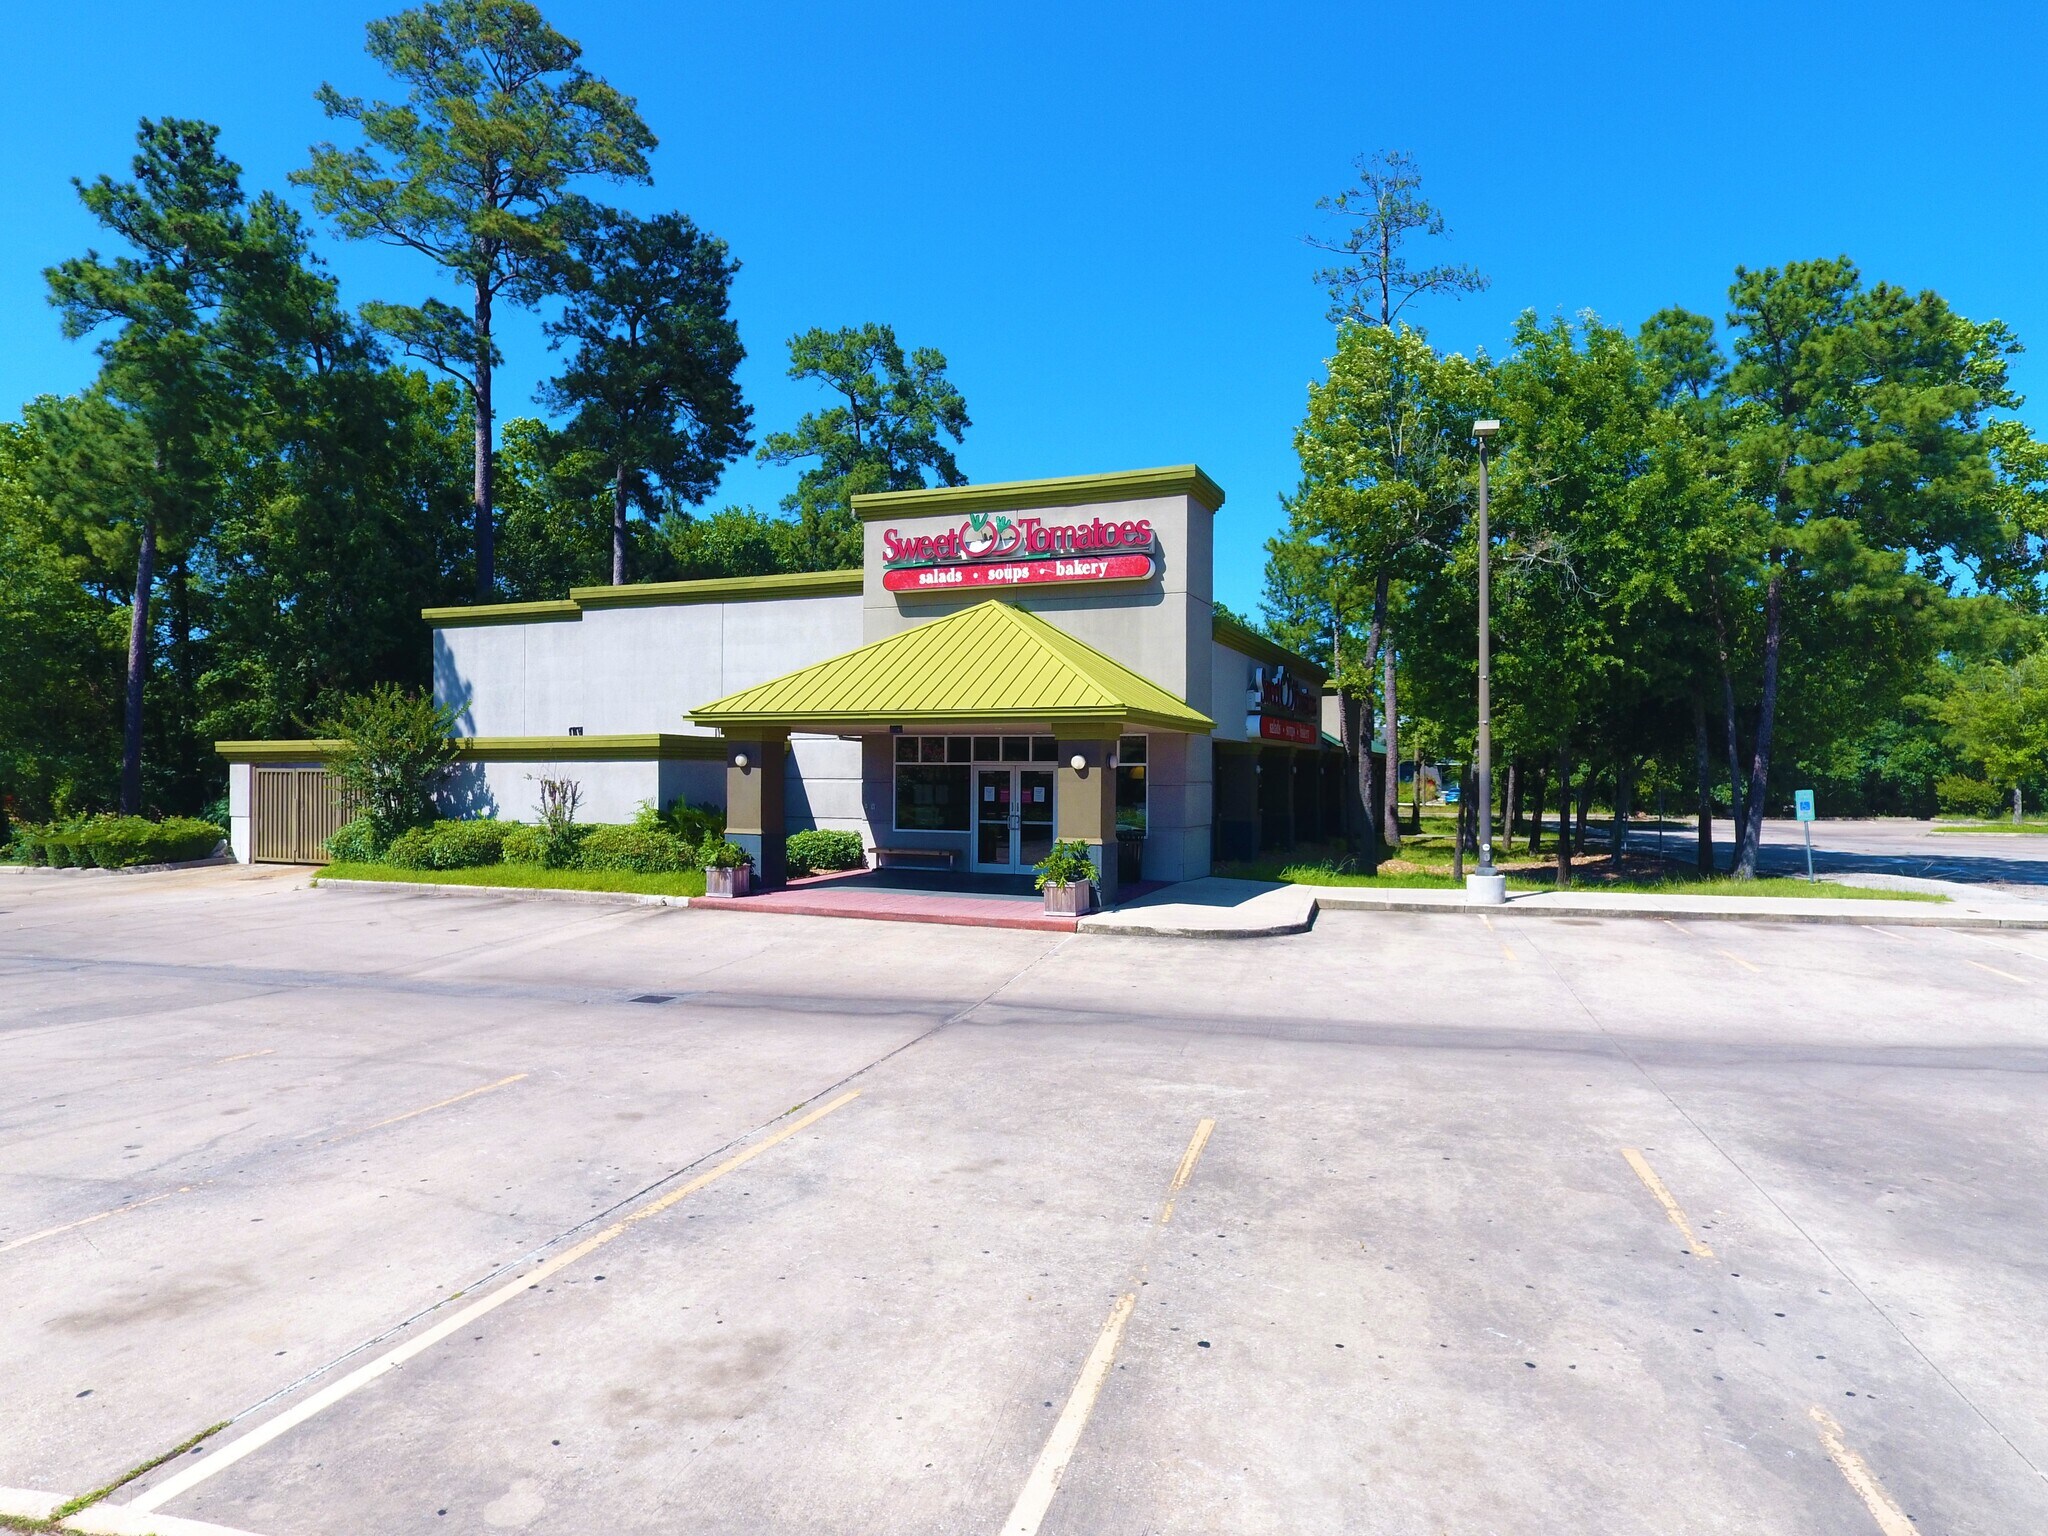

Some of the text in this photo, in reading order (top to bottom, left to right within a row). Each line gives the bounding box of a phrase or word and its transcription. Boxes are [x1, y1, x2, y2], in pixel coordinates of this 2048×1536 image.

[883, 517, 1152, 561] Sweet Tomatoes
[918, 560, 1108, 584] salads soups bakery
